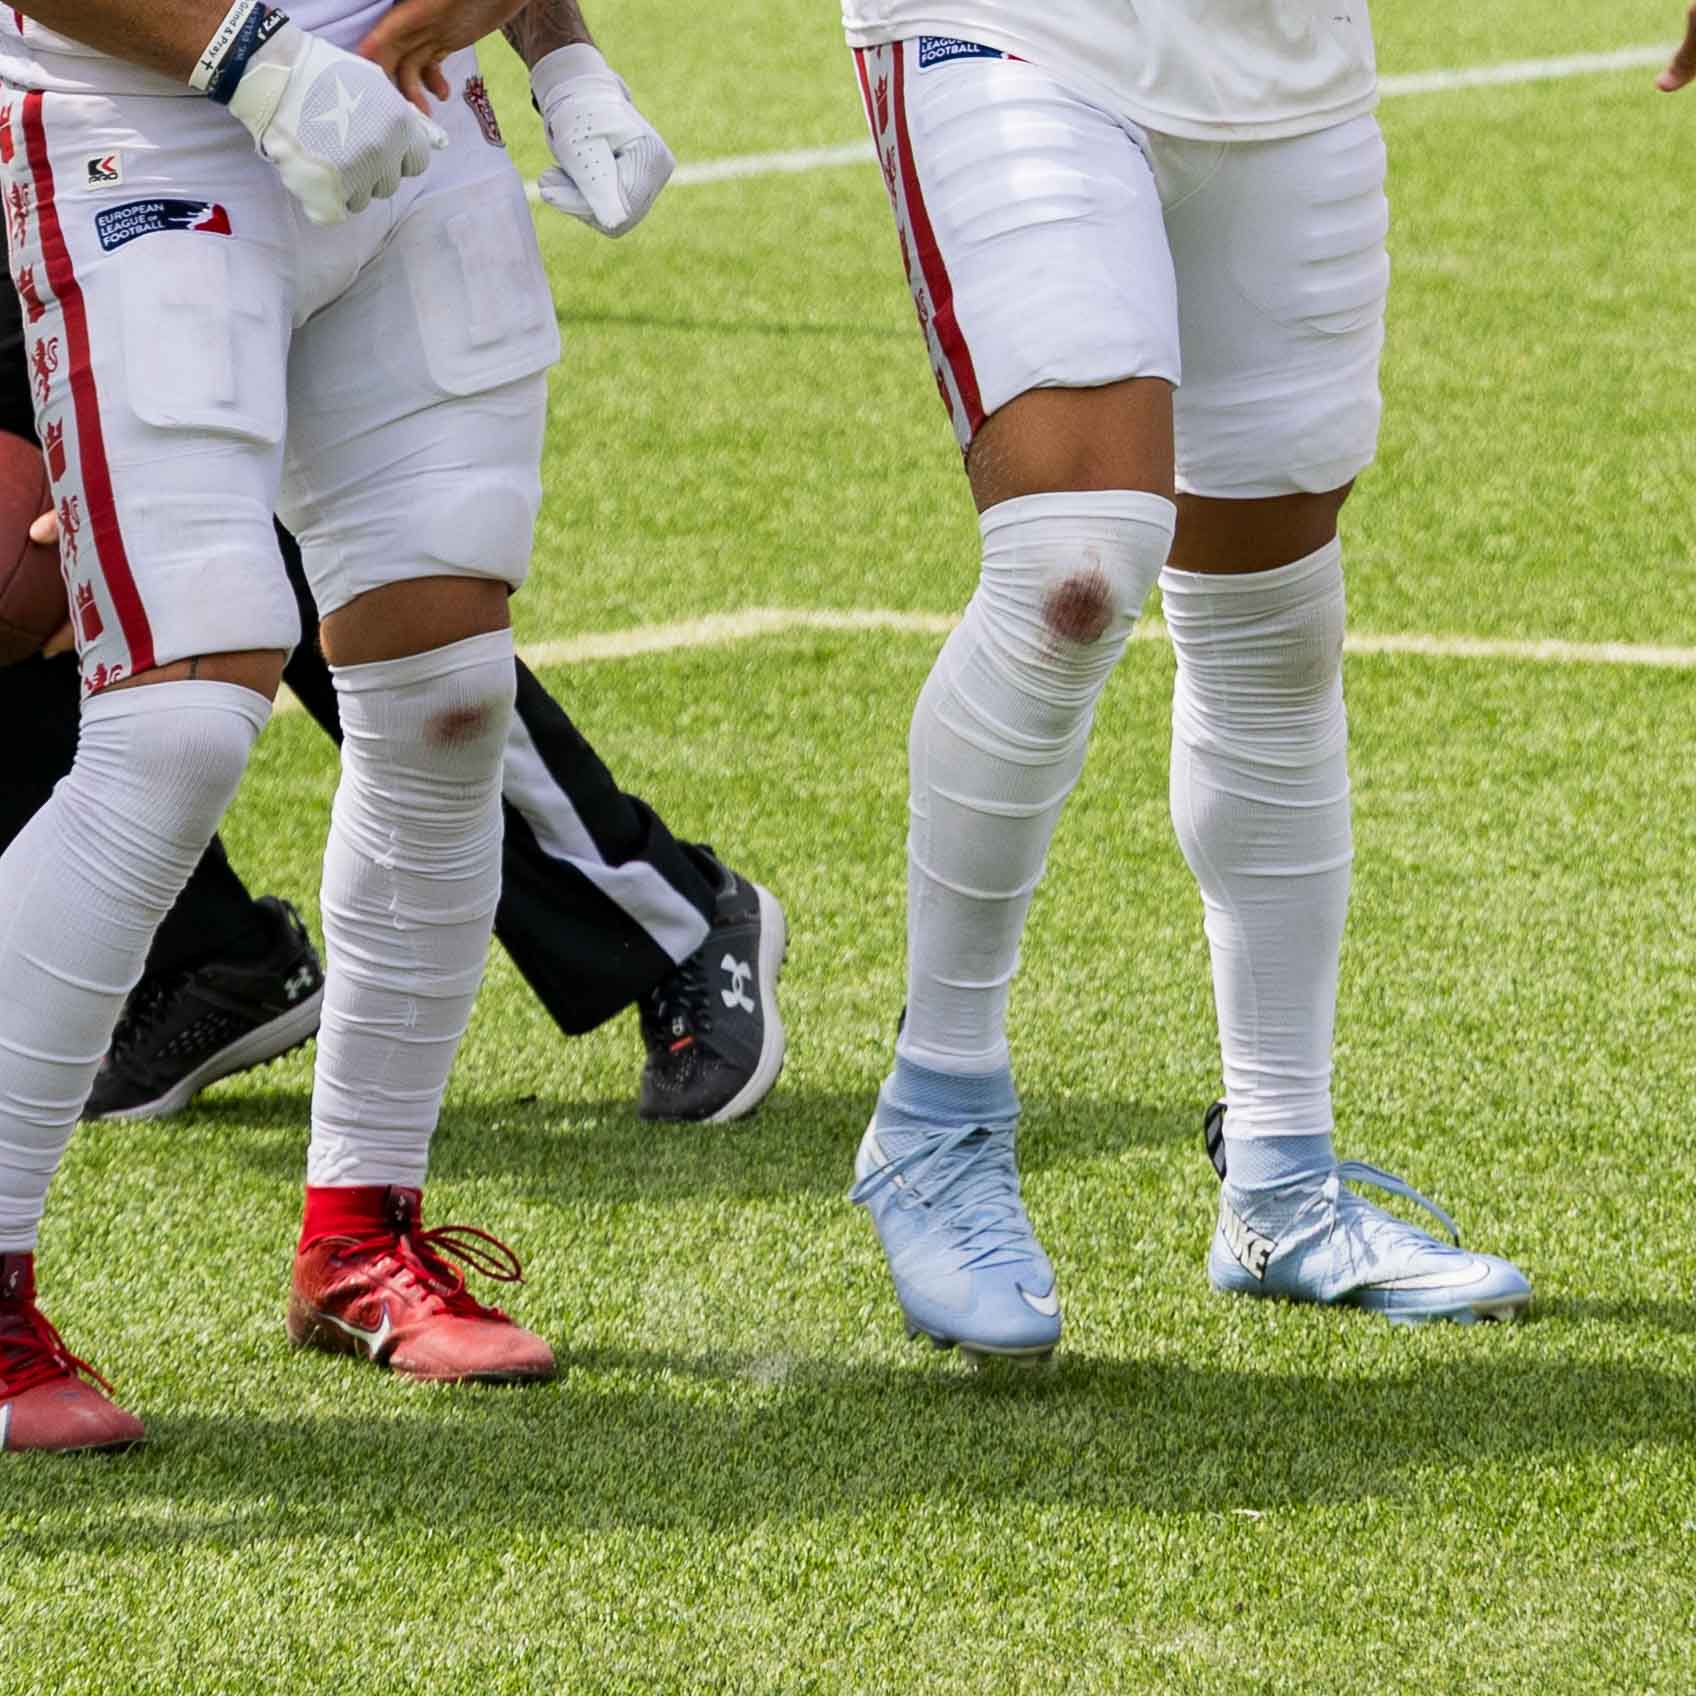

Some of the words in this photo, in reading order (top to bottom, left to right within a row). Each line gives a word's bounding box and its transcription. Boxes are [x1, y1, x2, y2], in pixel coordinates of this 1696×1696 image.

[921, 44, 981, 63] FOOTBALL
[98, 203, 165, 226] EUROPEAN
[100, 215, 146, 237] LEAGUE
[102, 220, 167, 247] FOOTBALL
